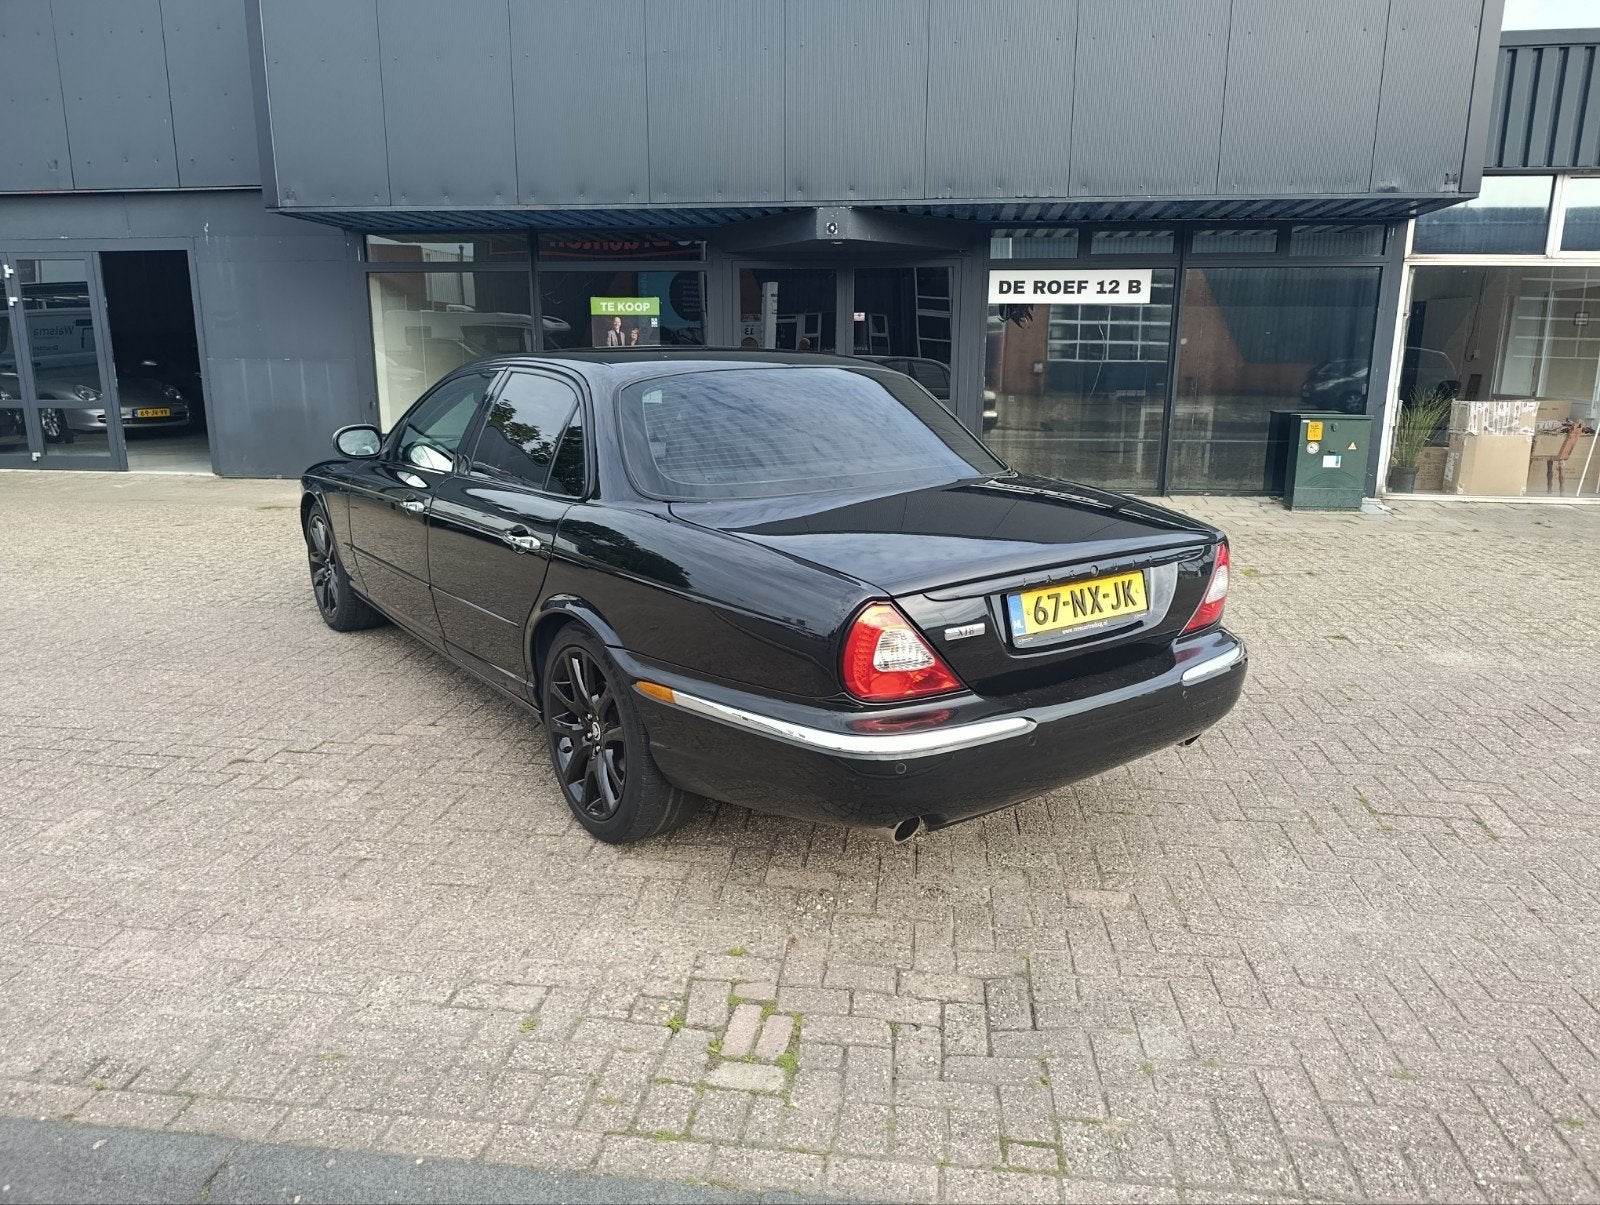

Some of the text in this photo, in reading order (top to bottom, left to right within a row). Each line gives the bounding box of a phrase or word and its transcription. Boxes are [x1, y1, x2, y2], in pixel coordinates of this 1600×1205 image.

[998, 280, 1142, 295] DE ROEF 12 B
[600, 301, 651, 312] TE KOOP
[1032, 579, 1138, 626] 67-NX-JK
